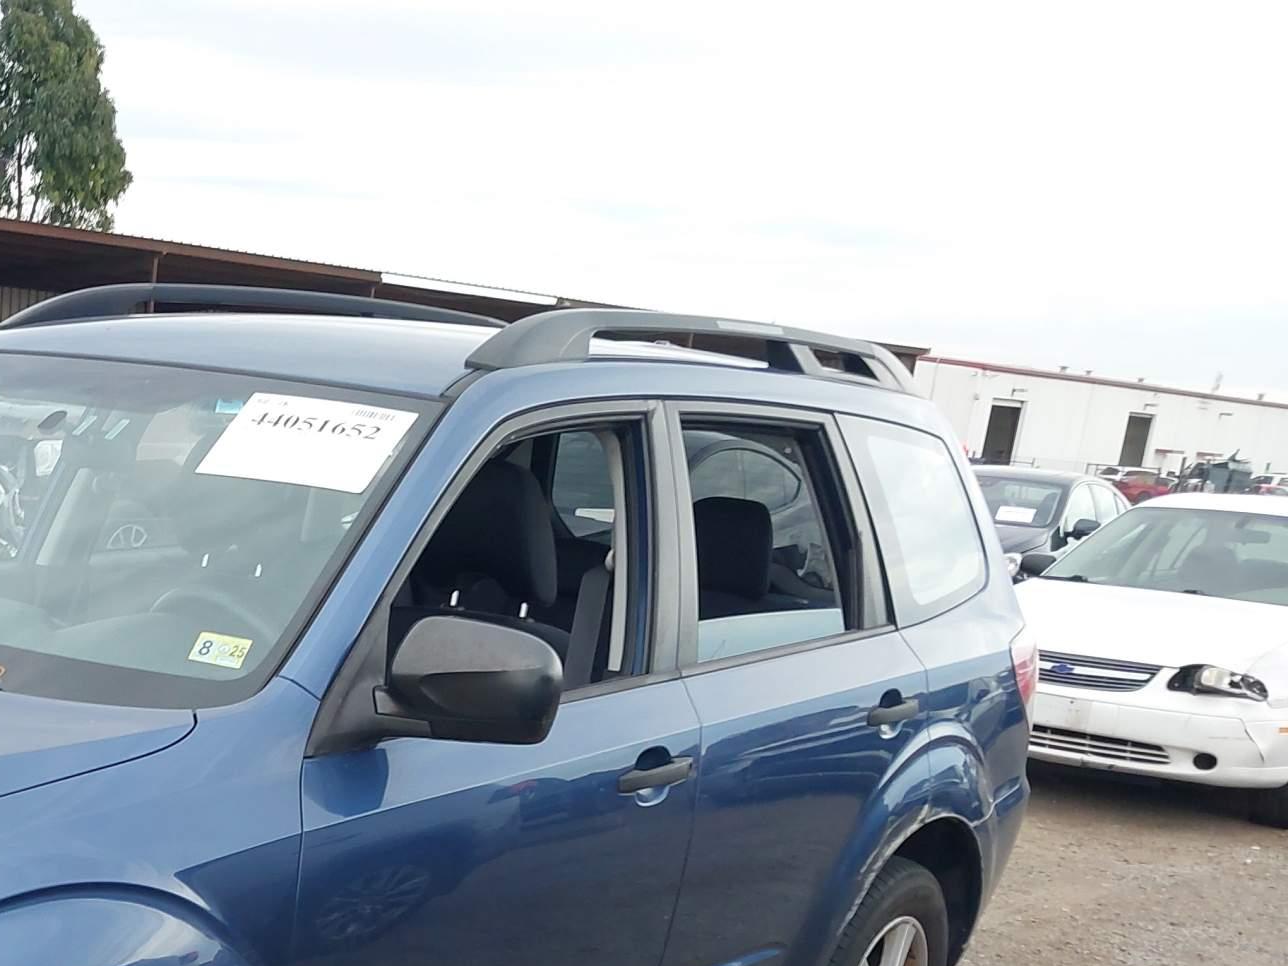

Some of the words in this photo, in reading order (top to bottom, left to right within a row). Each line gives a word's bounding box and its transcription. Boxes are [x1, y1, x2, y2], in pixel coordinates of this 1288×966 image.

[251, 412, 381, 440] 44051652
[198, 640, 213, 656] 8
[229, 645, 247, 658] 25
